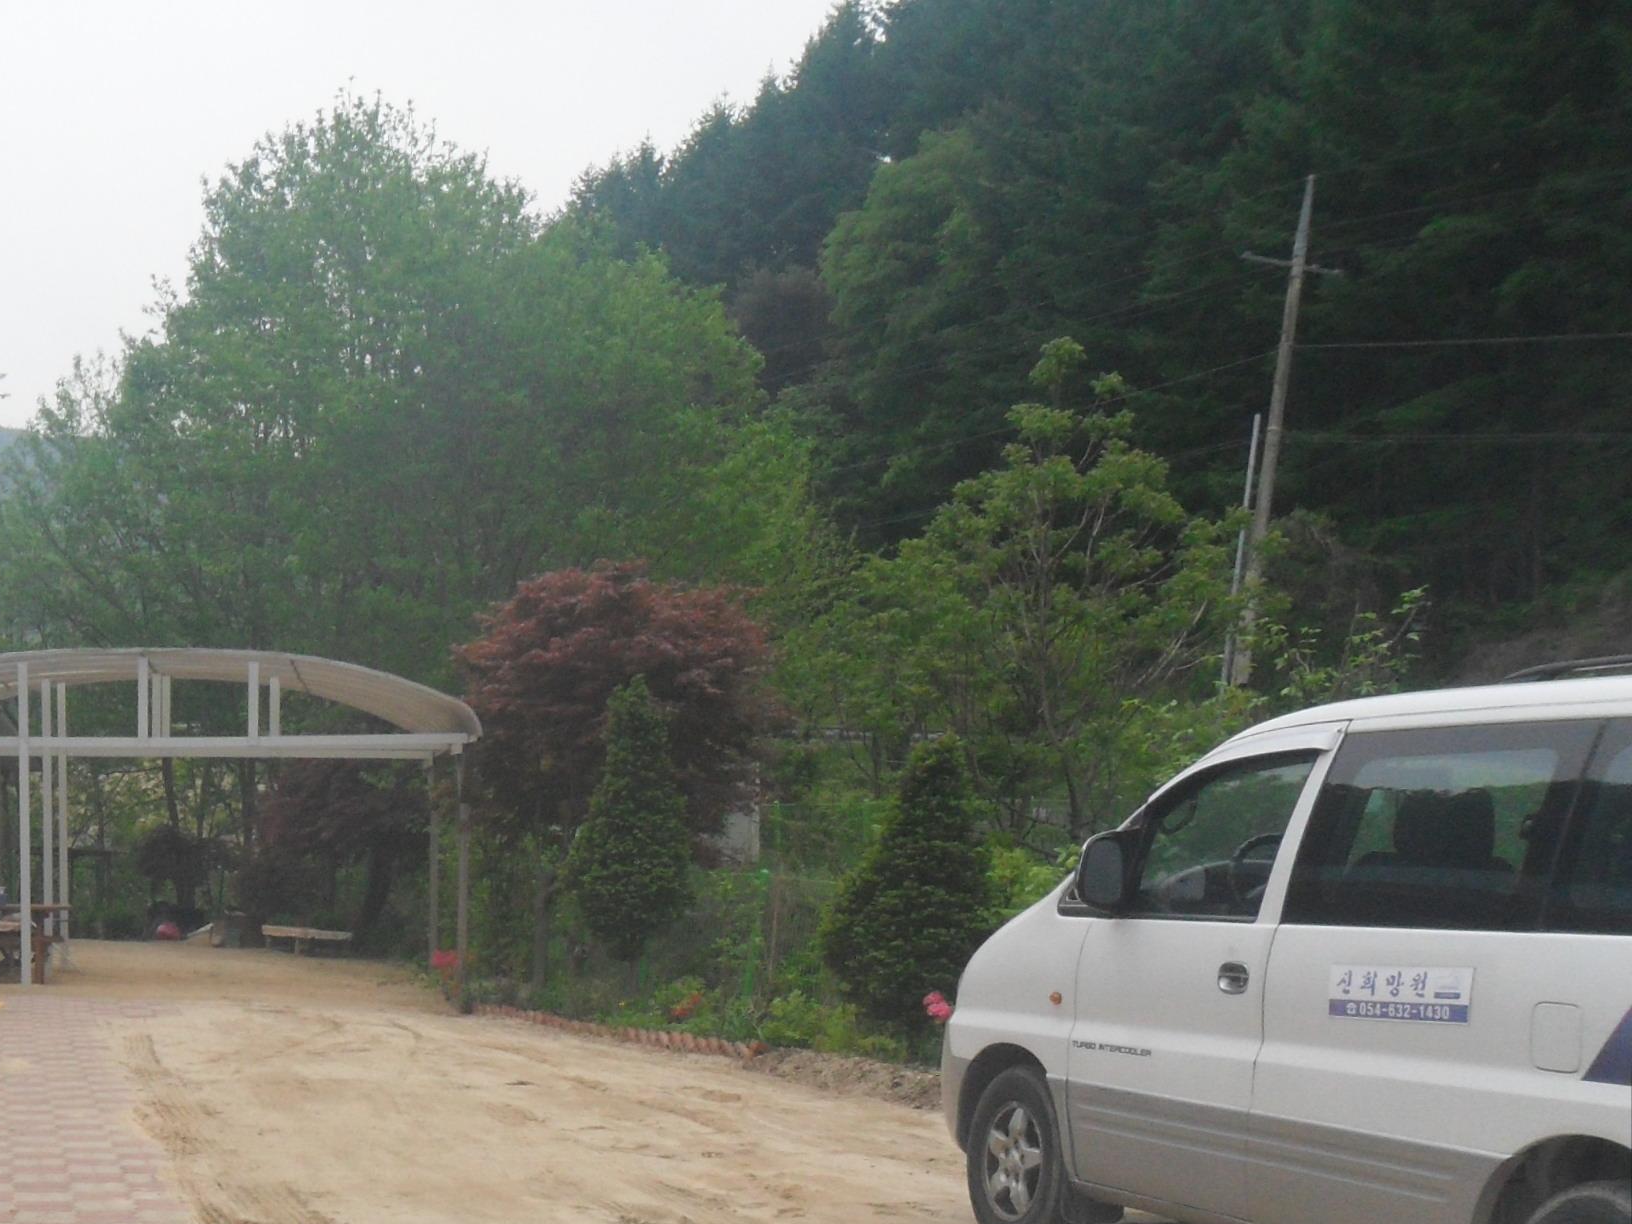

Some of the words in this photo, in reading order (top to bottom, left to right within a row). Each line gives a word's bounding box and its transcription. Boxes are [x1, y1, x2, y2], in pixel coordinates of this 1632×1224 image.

[1359, 1001, 1450, 1020] 054-632-1430
[1072, 1040, 1096, 1050] TURBO
[1098, 1043, 1152, 1057] INTERCOOLER
